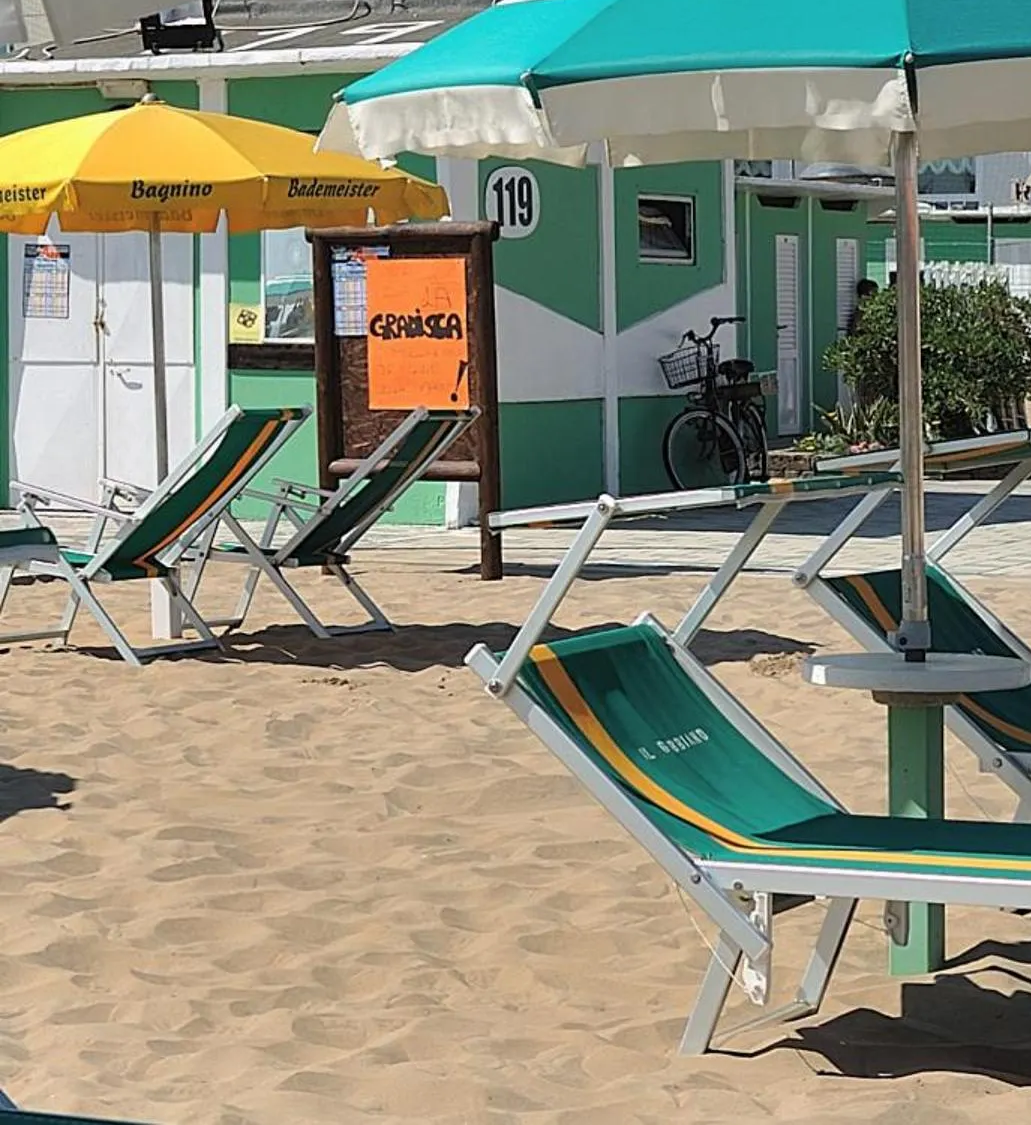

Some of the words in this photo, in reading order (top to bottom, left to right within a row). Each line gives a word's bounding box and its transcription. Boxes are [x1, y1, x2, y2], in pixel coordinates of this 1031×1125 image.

[131, 180, 213, 202] Bagnino
[288, 177, 380, 197] Bademeister
[493, 176, 533, 227] 119
